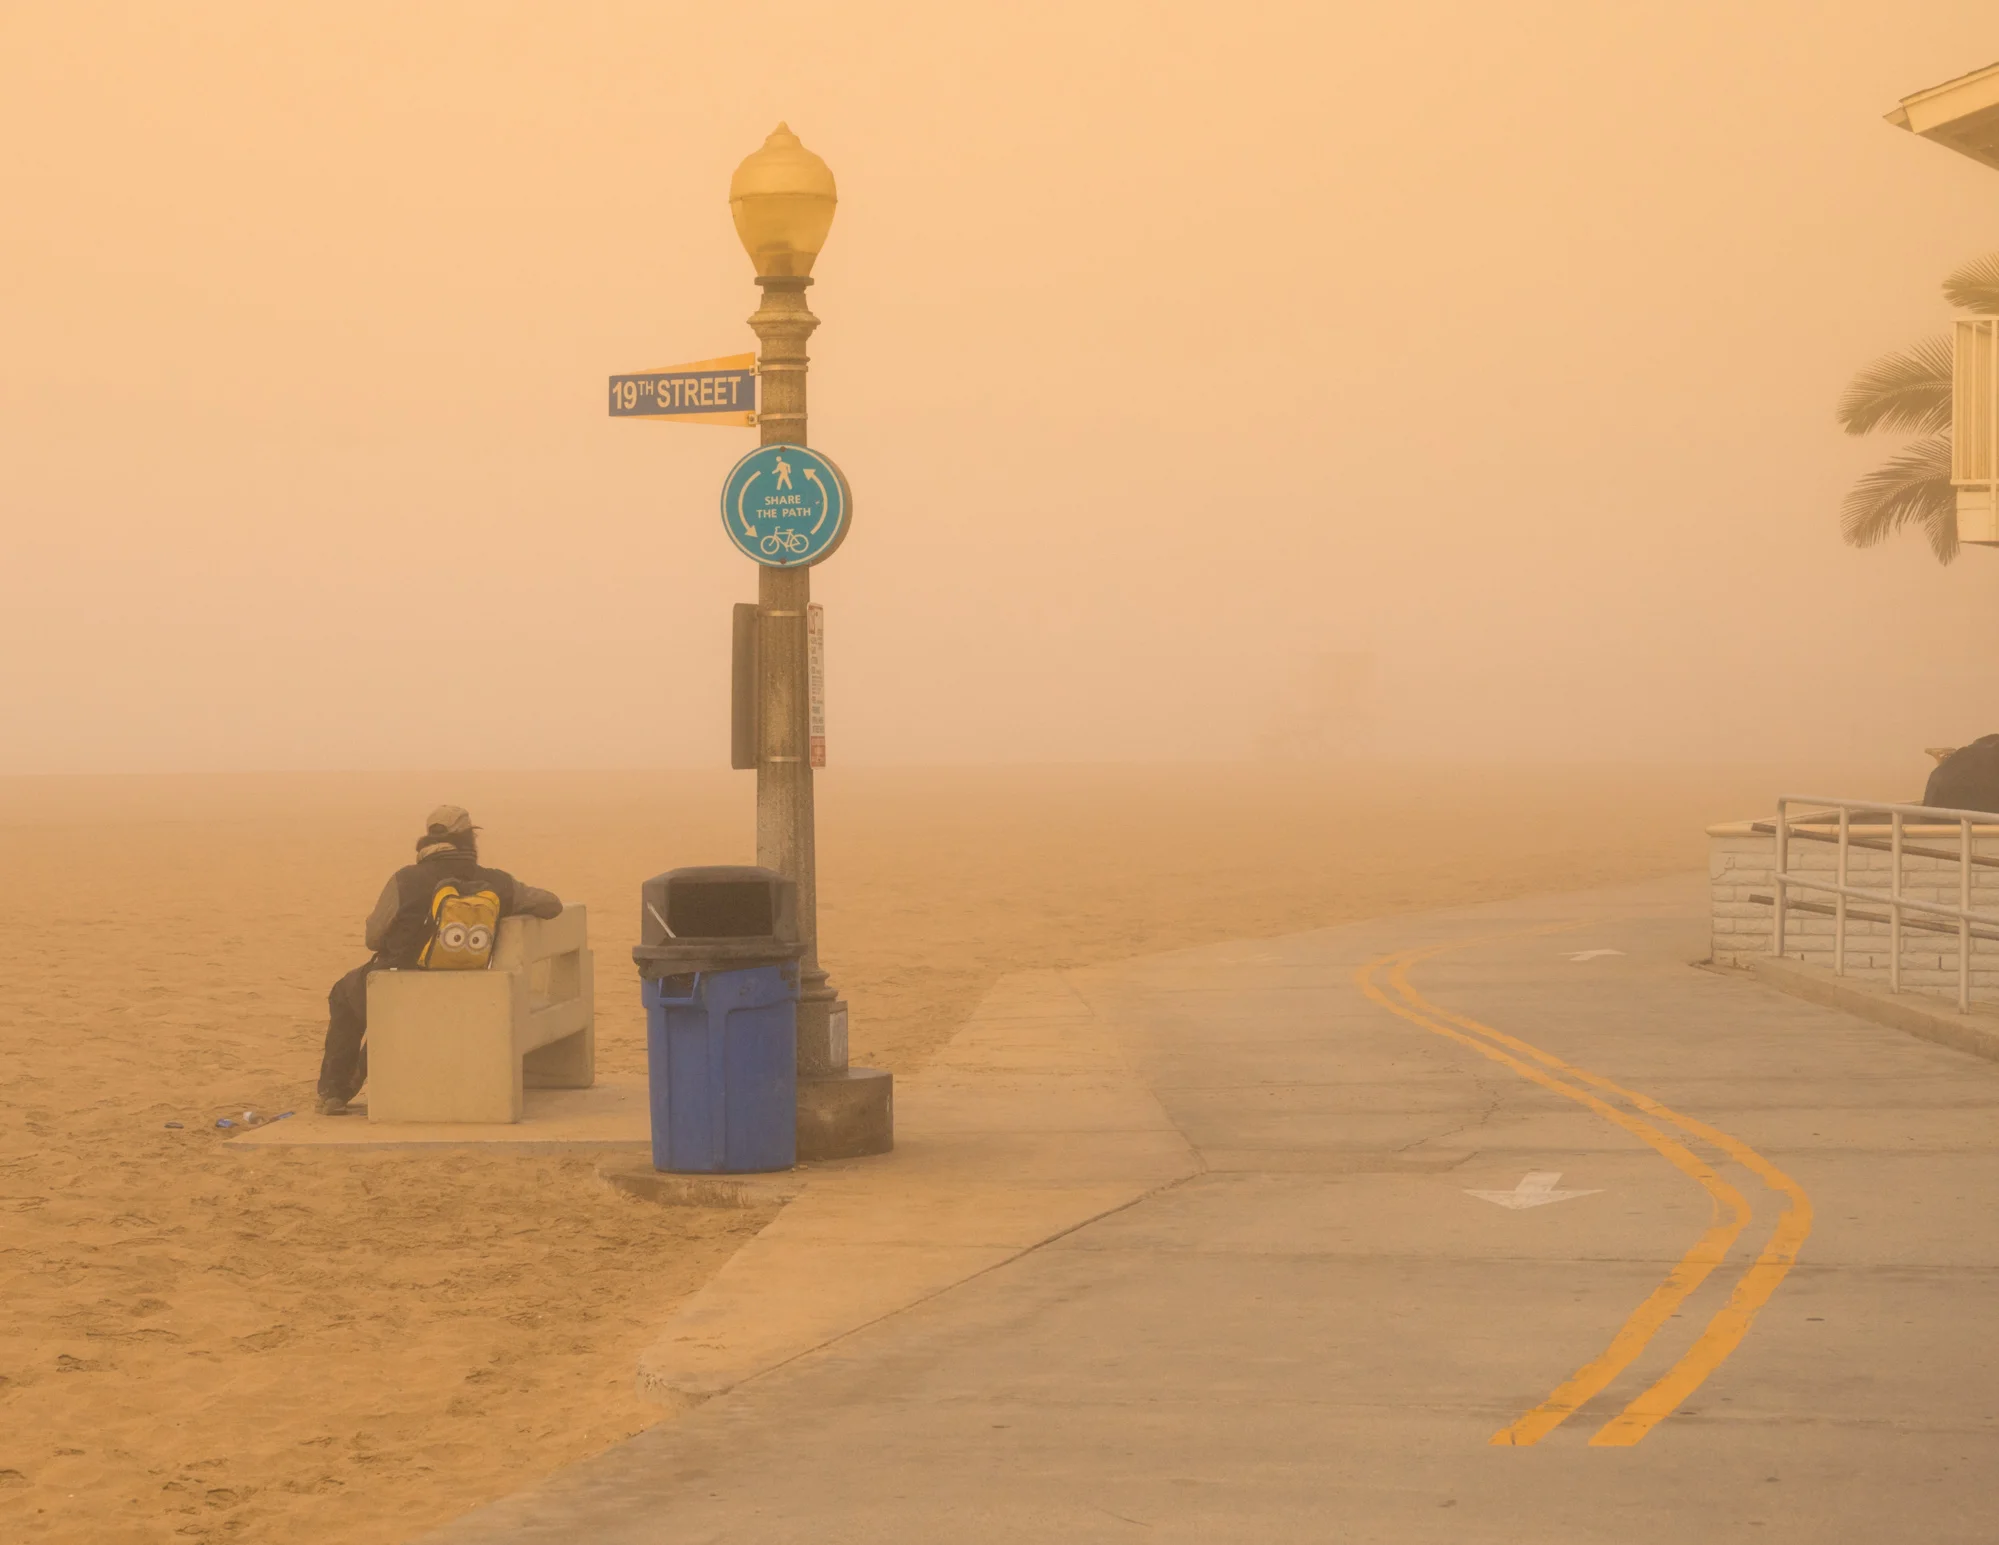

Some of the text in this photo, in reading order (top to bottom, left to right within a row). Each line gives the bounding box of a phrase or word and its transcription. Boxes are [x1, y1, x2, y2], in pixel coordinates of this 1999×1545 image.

[612, 376, 741, 409] 19TH STREET
[765, 495, 801, 505] SHARE
[756, 507, 811, 518] THE PATH
